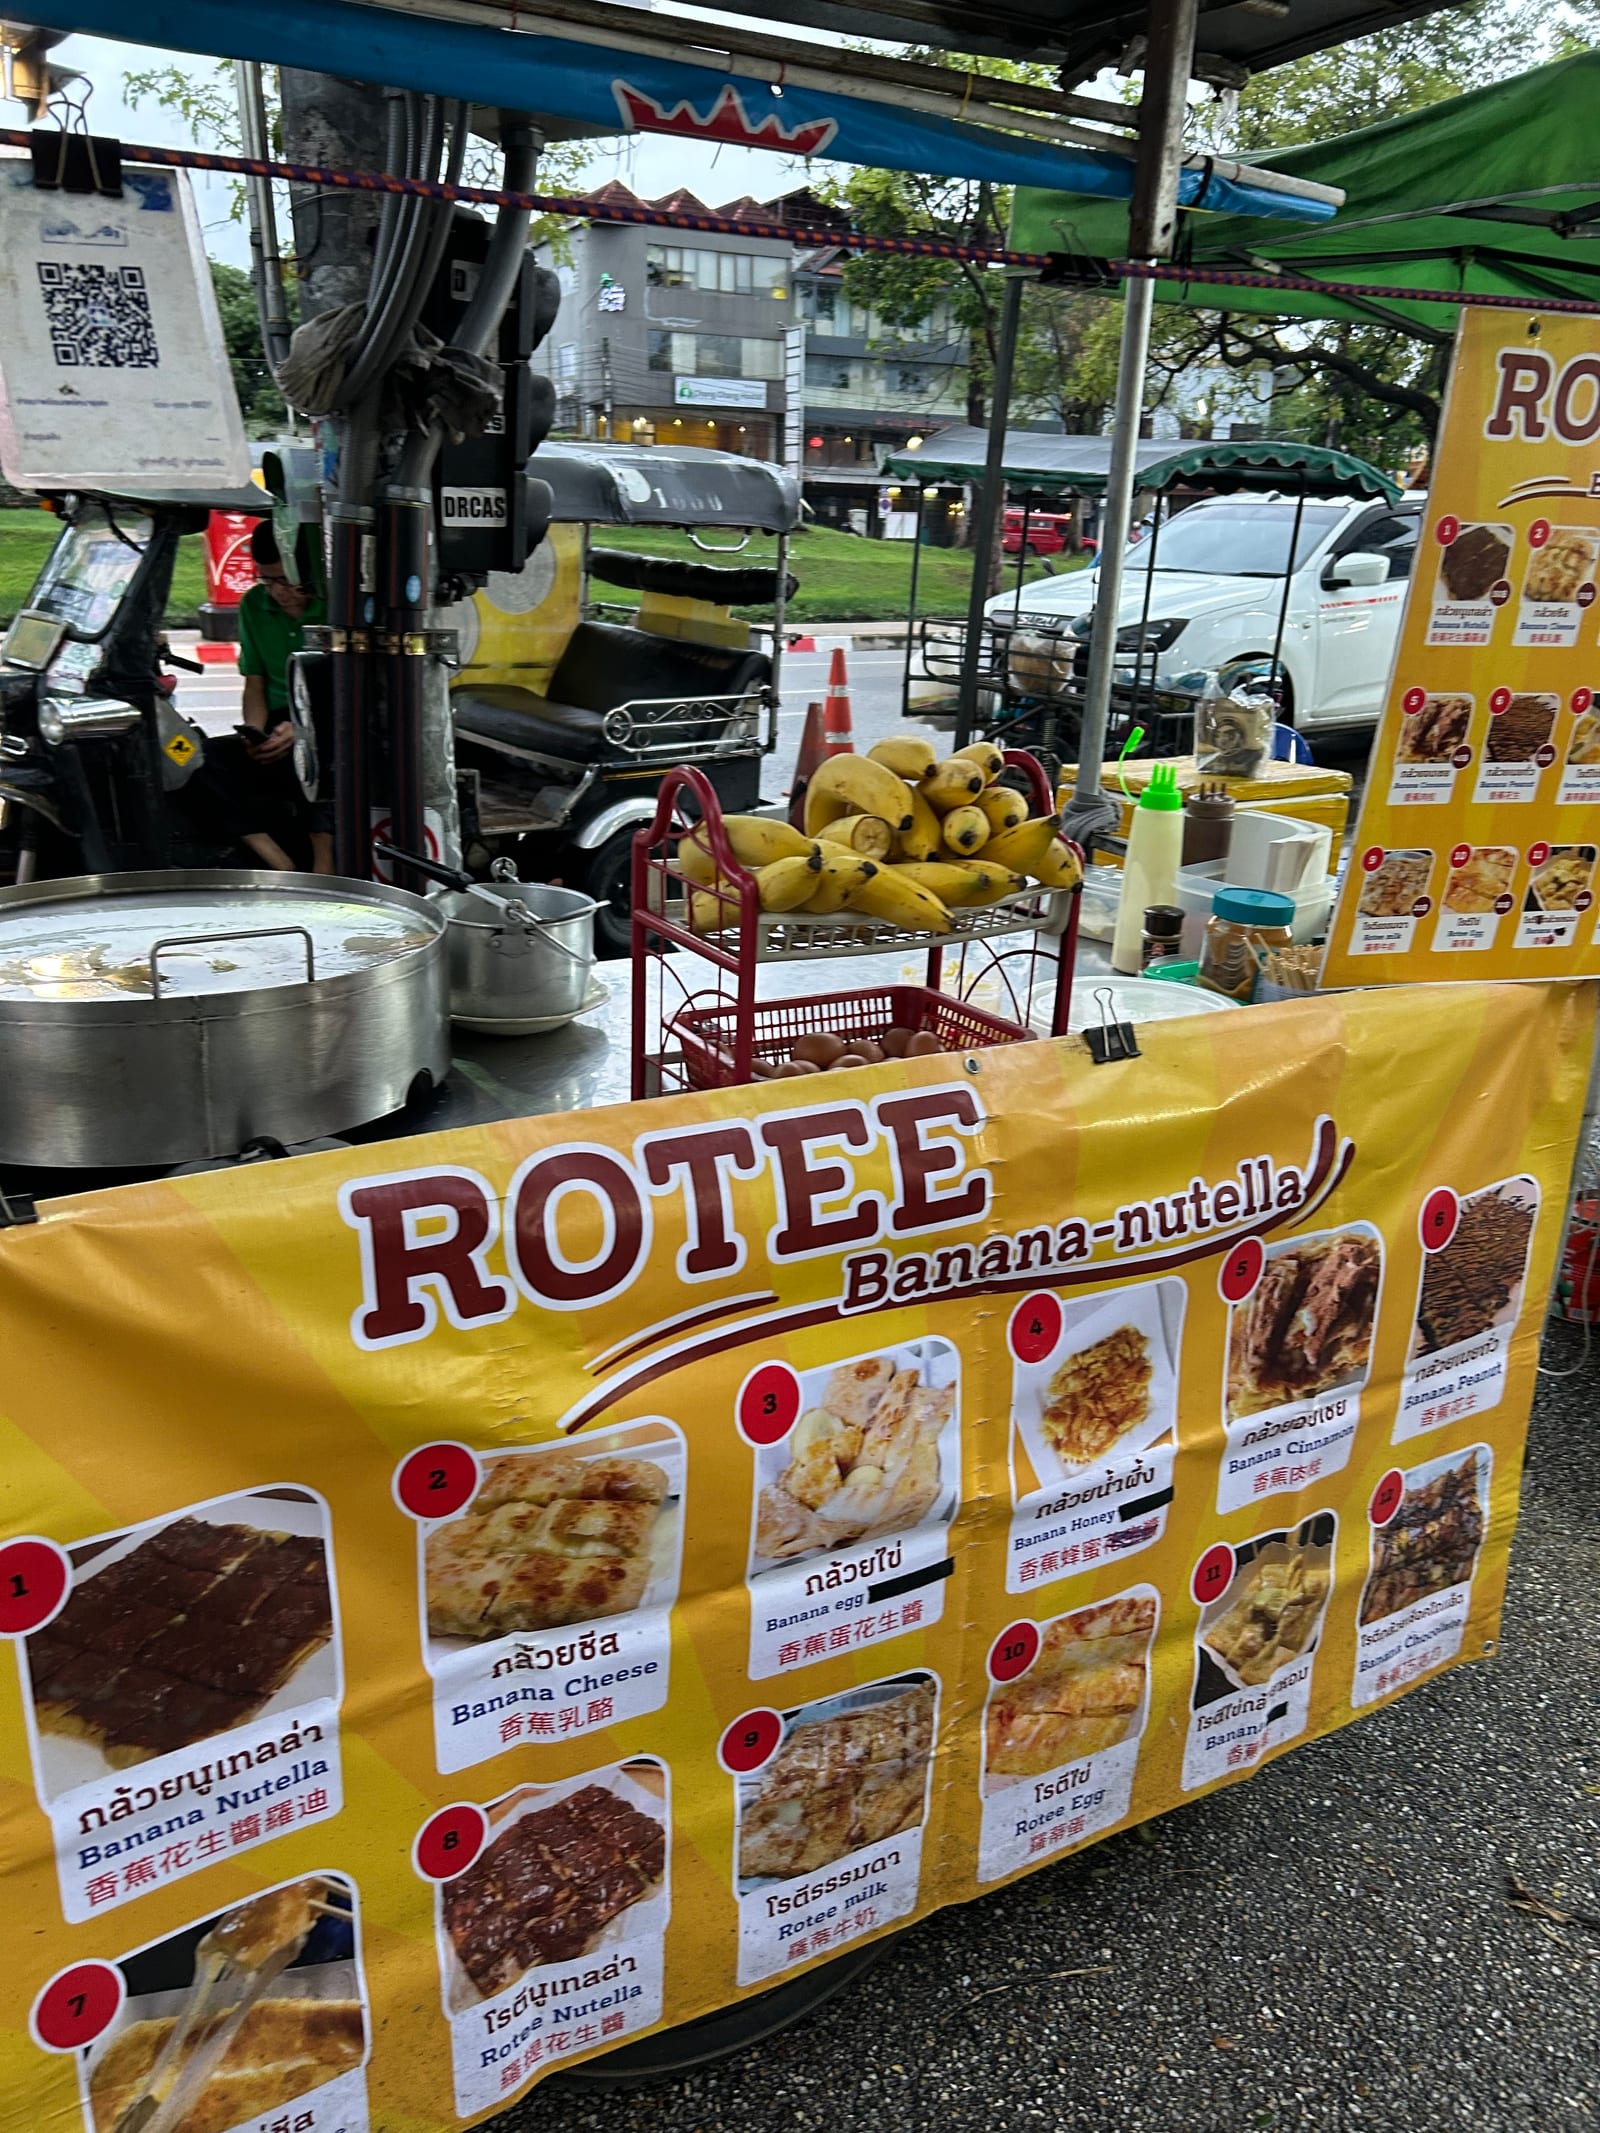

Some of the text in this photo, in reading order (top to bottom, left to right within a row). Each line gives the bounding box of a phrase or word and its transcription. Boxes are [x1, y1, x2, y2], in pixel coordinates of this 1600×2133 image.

[1533, 527, 1544, 539] 2
[1409, 695, 1419, 706] 5
[347, 1086, 988, 1342] ROTEE
[842, 1158, 1304, 1310] Banana-nutella
[1434, 1211, 1445, 1227] 6
[1236, 1260, 1248, 1277] 5
[1029, 1317, 1044, 1336] 4
[762, 1393, 778, 1415] 3
[1403, 1362, 1502, 1410] Banana Peanut
[1241, 1398, 1348, 1448] กล้วยอบเชย
[1228, 1425, 1355, 1474] Banana Cinnamon
[428, 1469, 449, 1491] 2
[1034, 1458, 1156, 1520] กล้วยน้ำผึ้ง
[1014, 1509, 1116, 1551] Banana Honey
[11, 1574, 29, 1598] 1
[805, 1540, 903, 1596] กล้วยไข่
[1205, 1564, 1221, 1583] 11
[765, 1593, 865, 1633] Banana egg
[777, 1599, 924, 1667] 香蕉蛋花生醬
[491, 1630, 620, 1679] กล้วยชีส
[1002, 1641, 1026, 1662] 10
[452, 1660, 659, 1727] Banana Cheese
[498, 1696, 614, 1744] 香蕉乳酪
[743, 1730, 759, 1748] 9
[77, 1720, 325, 1835] กล้วยนูเทลล่า
[1033, 1761, 1093, 1804] โรตีไข่
[78, 1759, 330, 1870] Banana Nutella
[1015, 1788, 1106, 1837] Rotee Egg
[443, 1829, 459, 1850] 8
[778, 1882, 889, 1941] Rotee milk
[67, 1993, 87, 2018] 7
[483, 1953, 638, 2035] โรตีนูเทลล่า
[480, 1984, 643, 2069] Rotee Nutella
